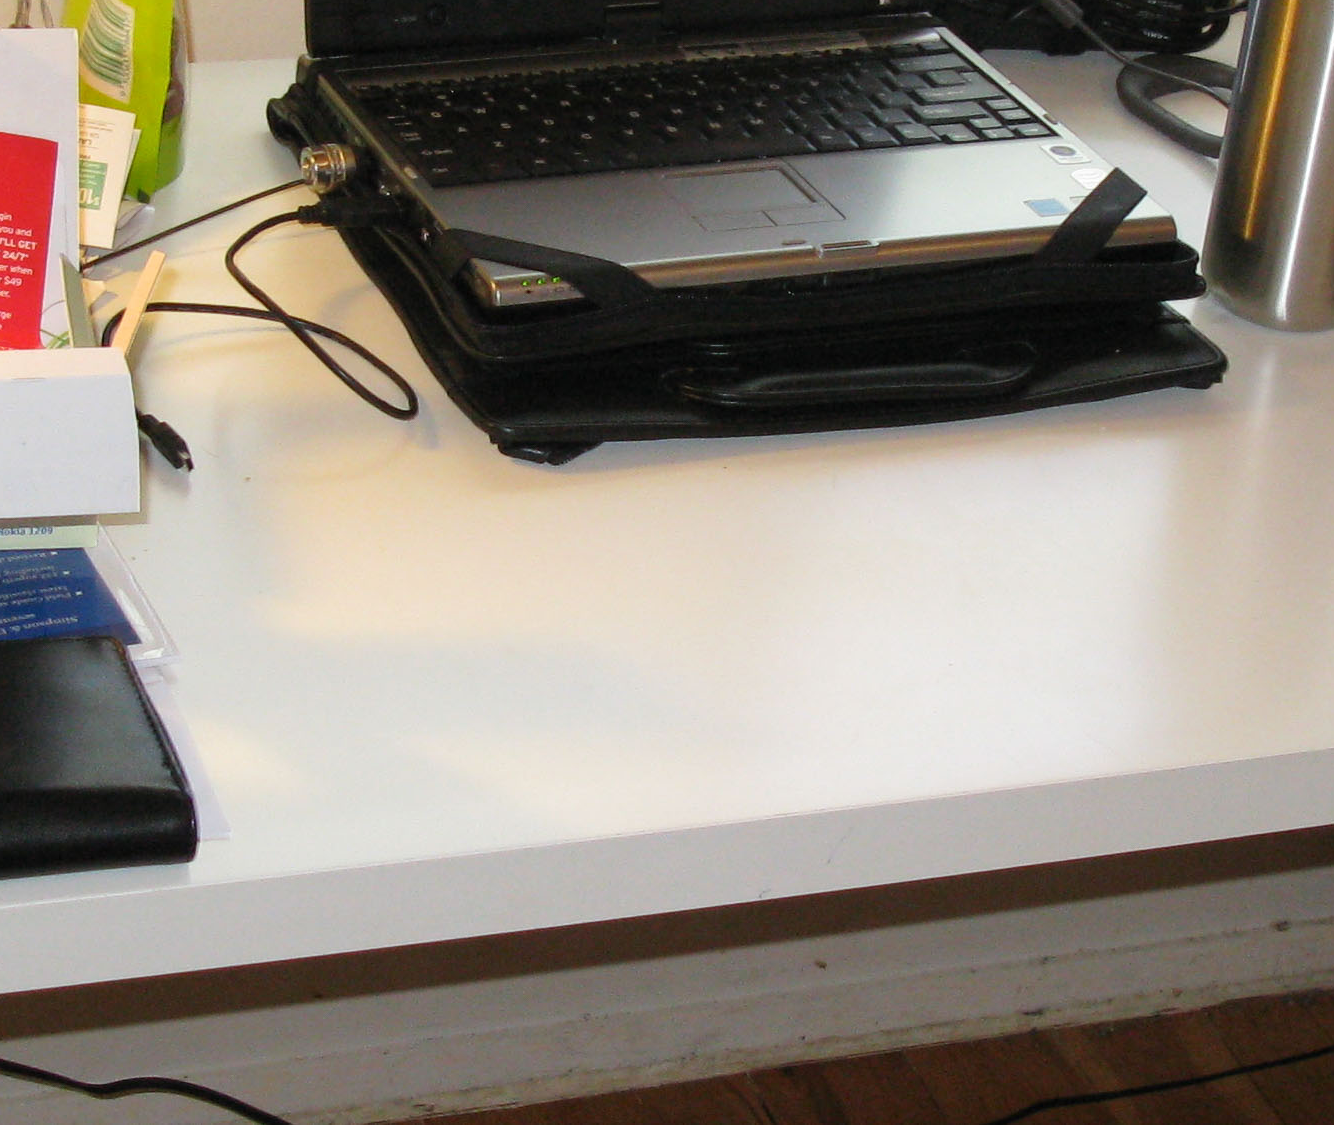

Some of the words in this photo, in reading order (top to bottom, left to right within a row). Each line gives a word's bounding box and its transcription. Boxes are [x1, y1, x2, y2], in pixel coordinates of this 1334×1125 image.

[15, 227, 32, 237] and
[18, 240, 38, 250] GET
[10, 264, 33, 275] when
[4, 275, 22, 286] $49
[30, 526, 54, 536] 1209
[22, 616, 79, 630] Simpson
